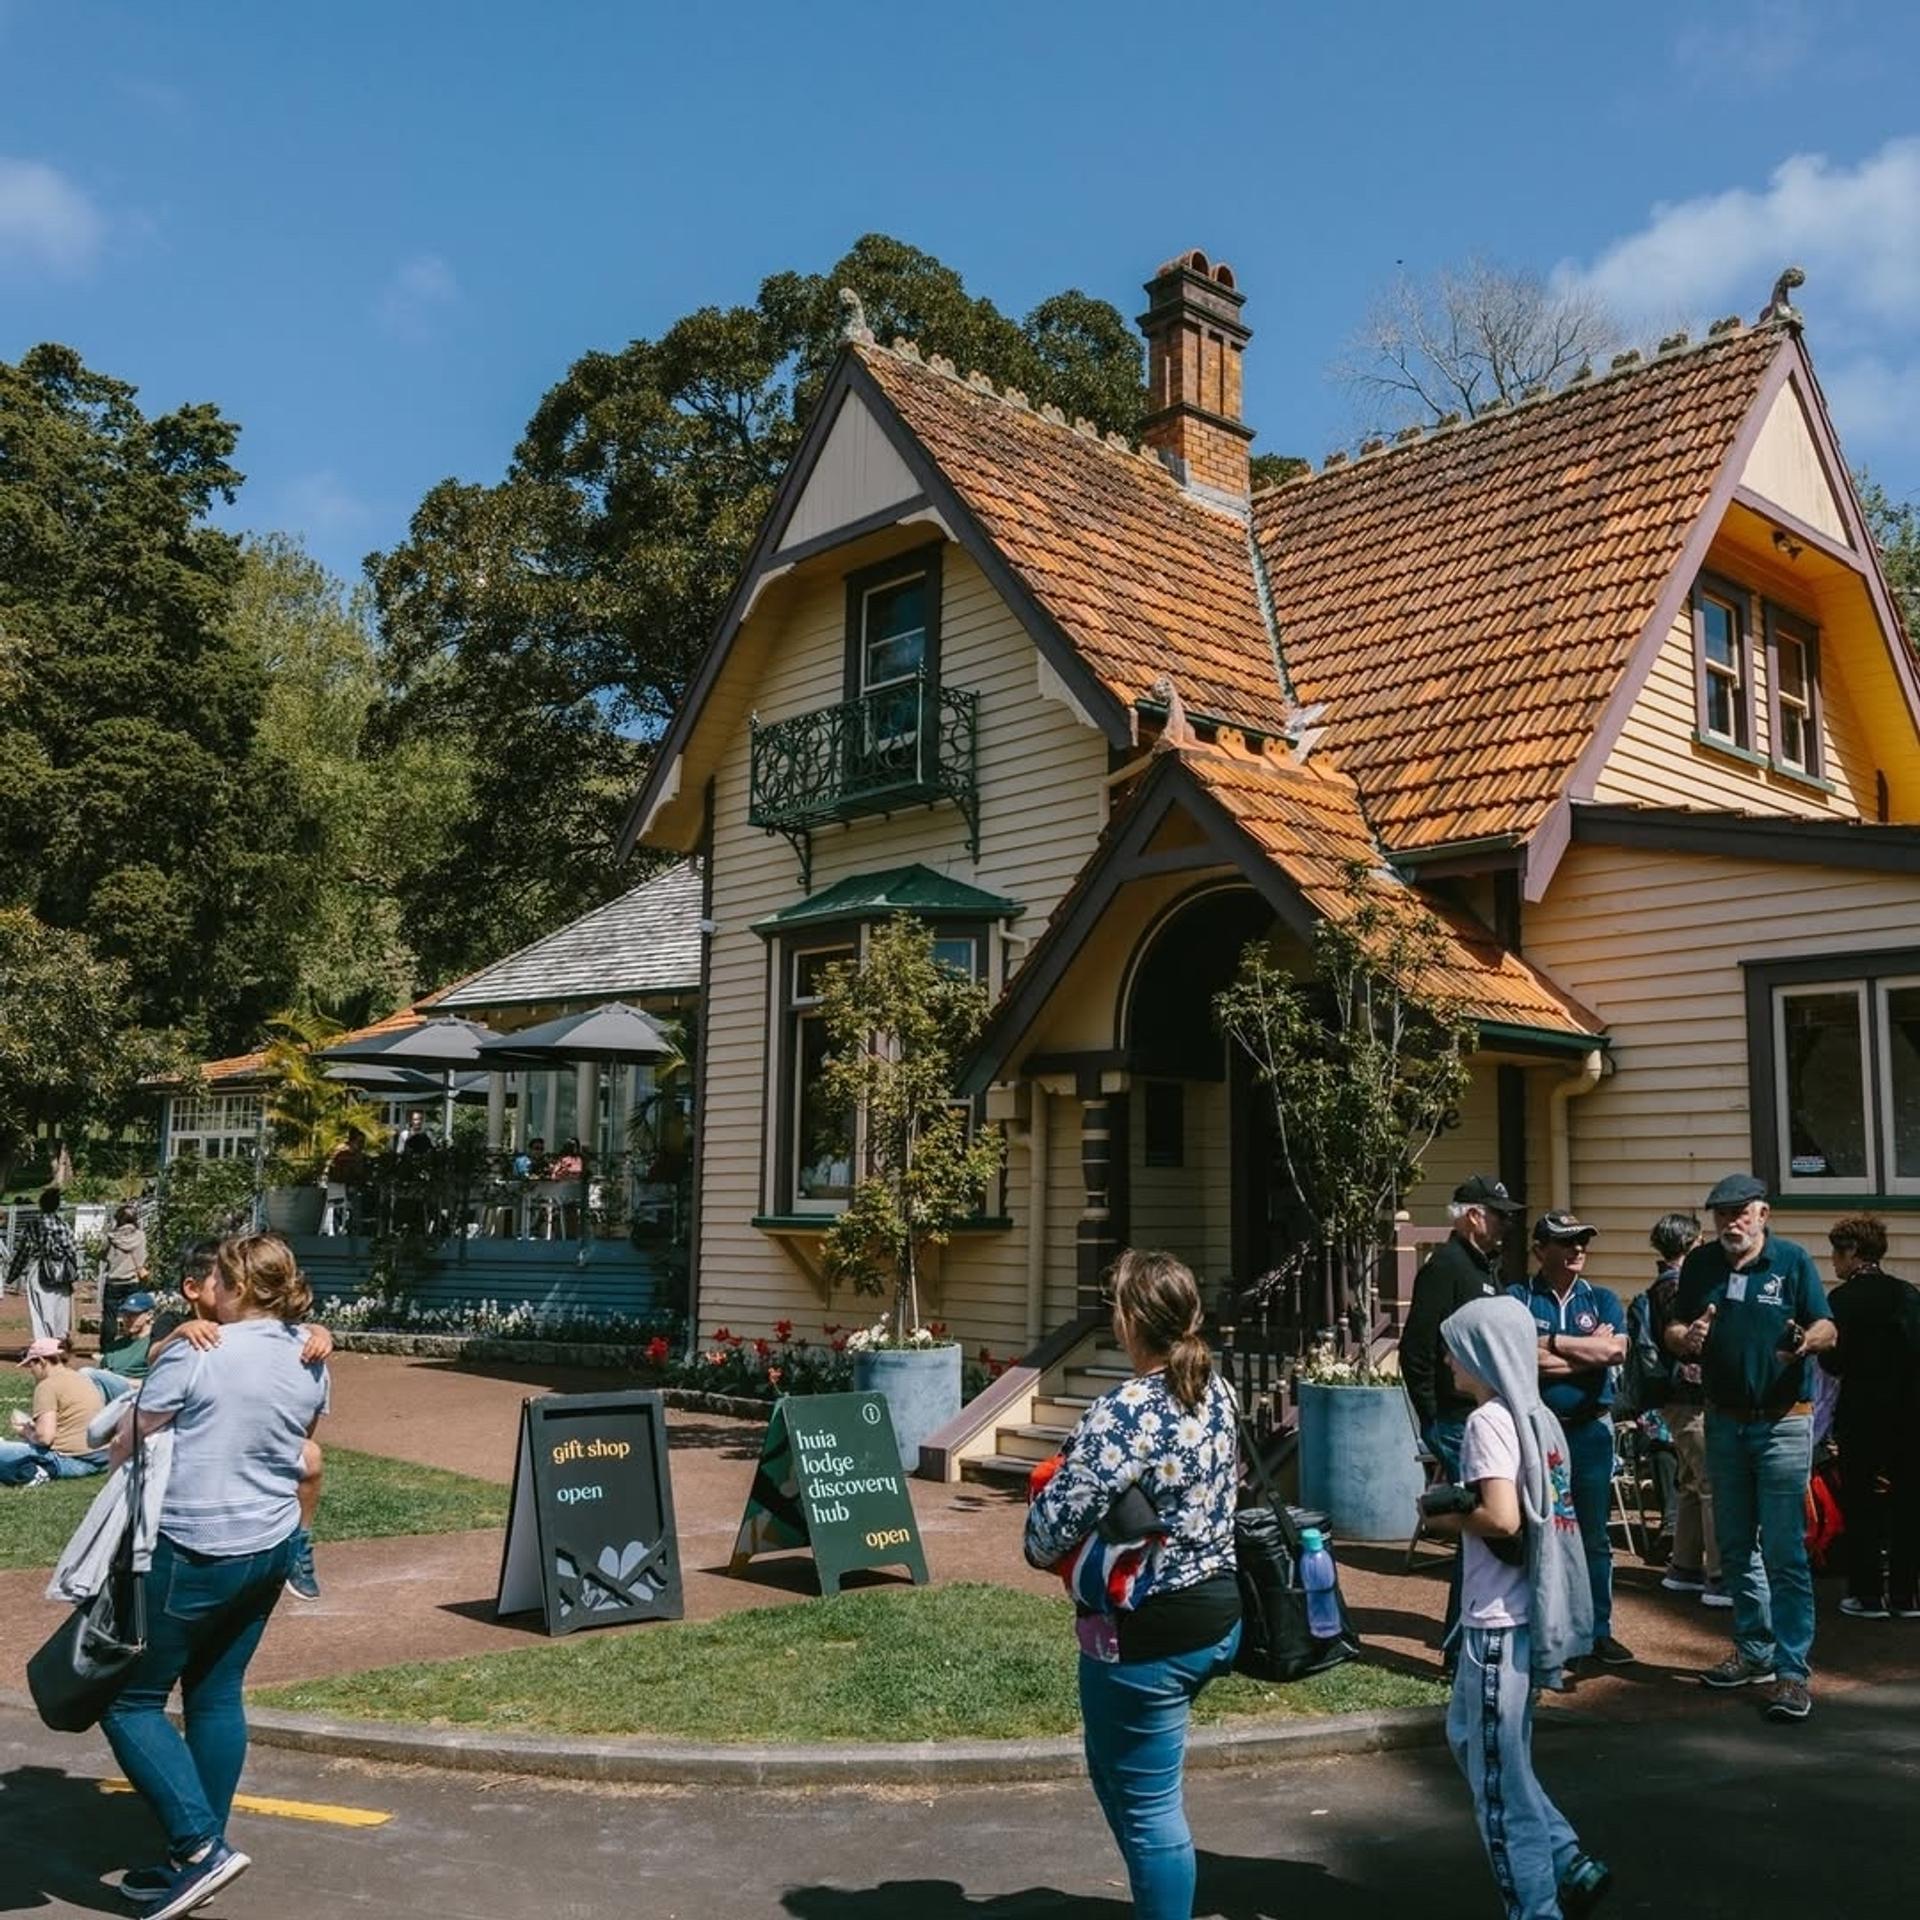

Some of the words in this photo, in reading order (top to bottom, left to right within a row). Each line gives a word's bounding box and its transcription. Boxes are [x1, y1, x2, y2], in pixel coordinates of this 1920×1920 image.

[553, 1439, 584, 1464] gift
[587, 1438, 630, 1459] shop
[796, 1429, 837, 1450] huia
[801, 1452, 855, 1477] lodge
[557, 1485, 603, 1505] open
[808, 1476, 899, 1499] discovery
[811, 1500, 850, 1524] hub
[866, 1528, 910, 1550] open
